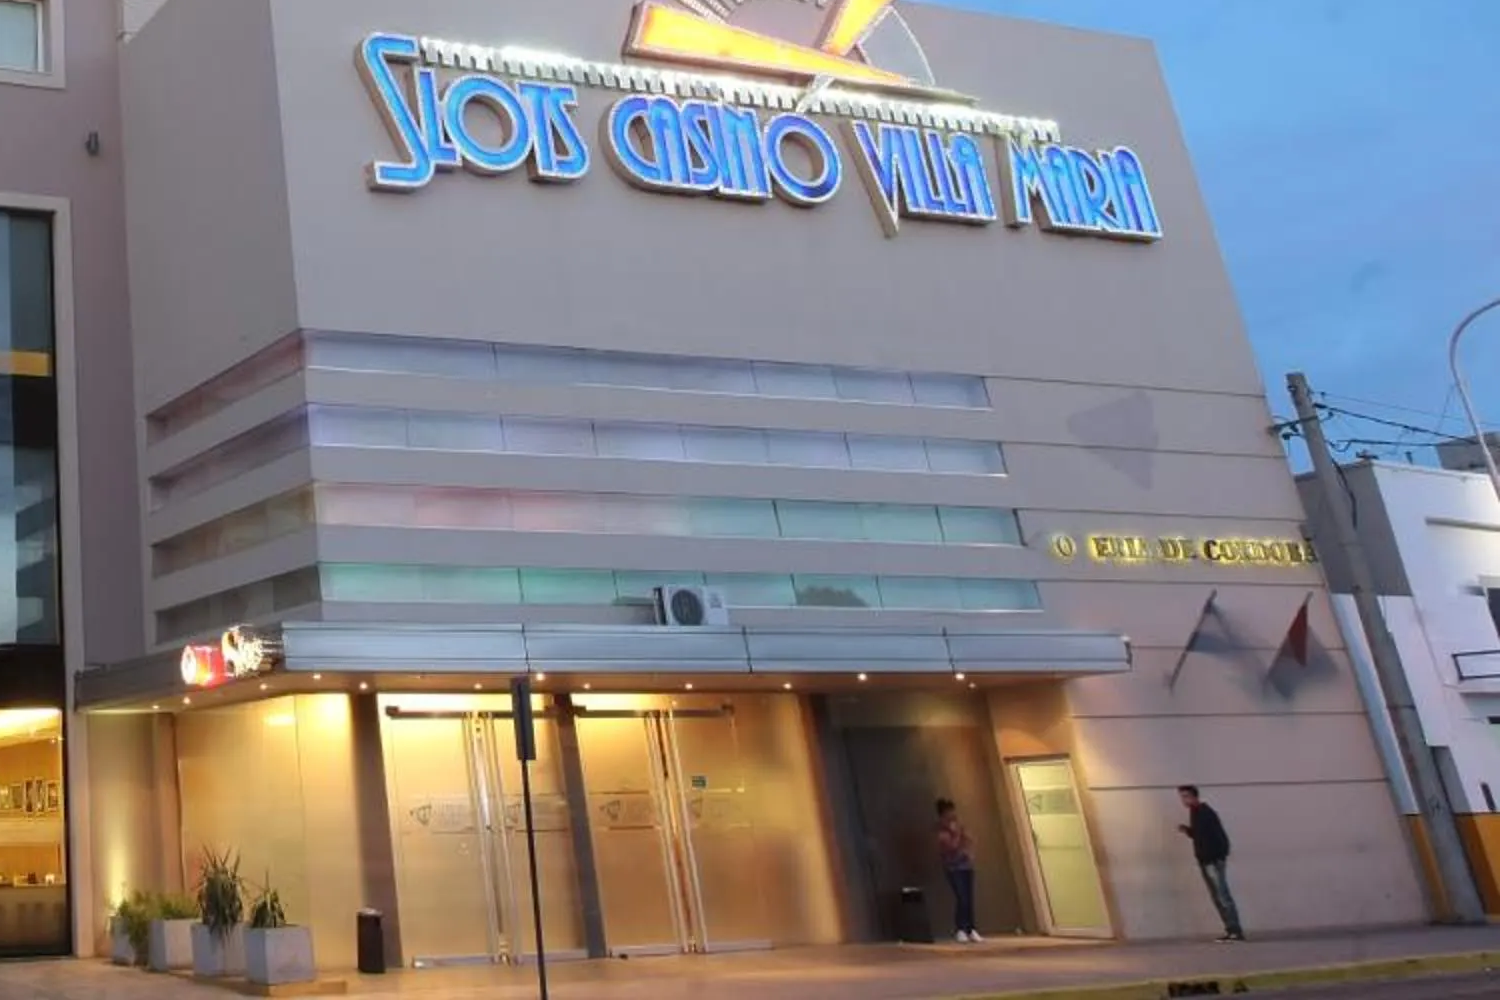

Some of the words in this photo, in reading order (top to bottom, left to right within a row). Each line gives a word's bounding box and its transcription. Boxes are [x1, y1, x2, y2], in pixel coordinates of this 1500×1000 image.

[359, 32, 590, 190] SLOTS
[607, 95, 841, 205] CASINO
[847, 118, 999, 236] VILLA
